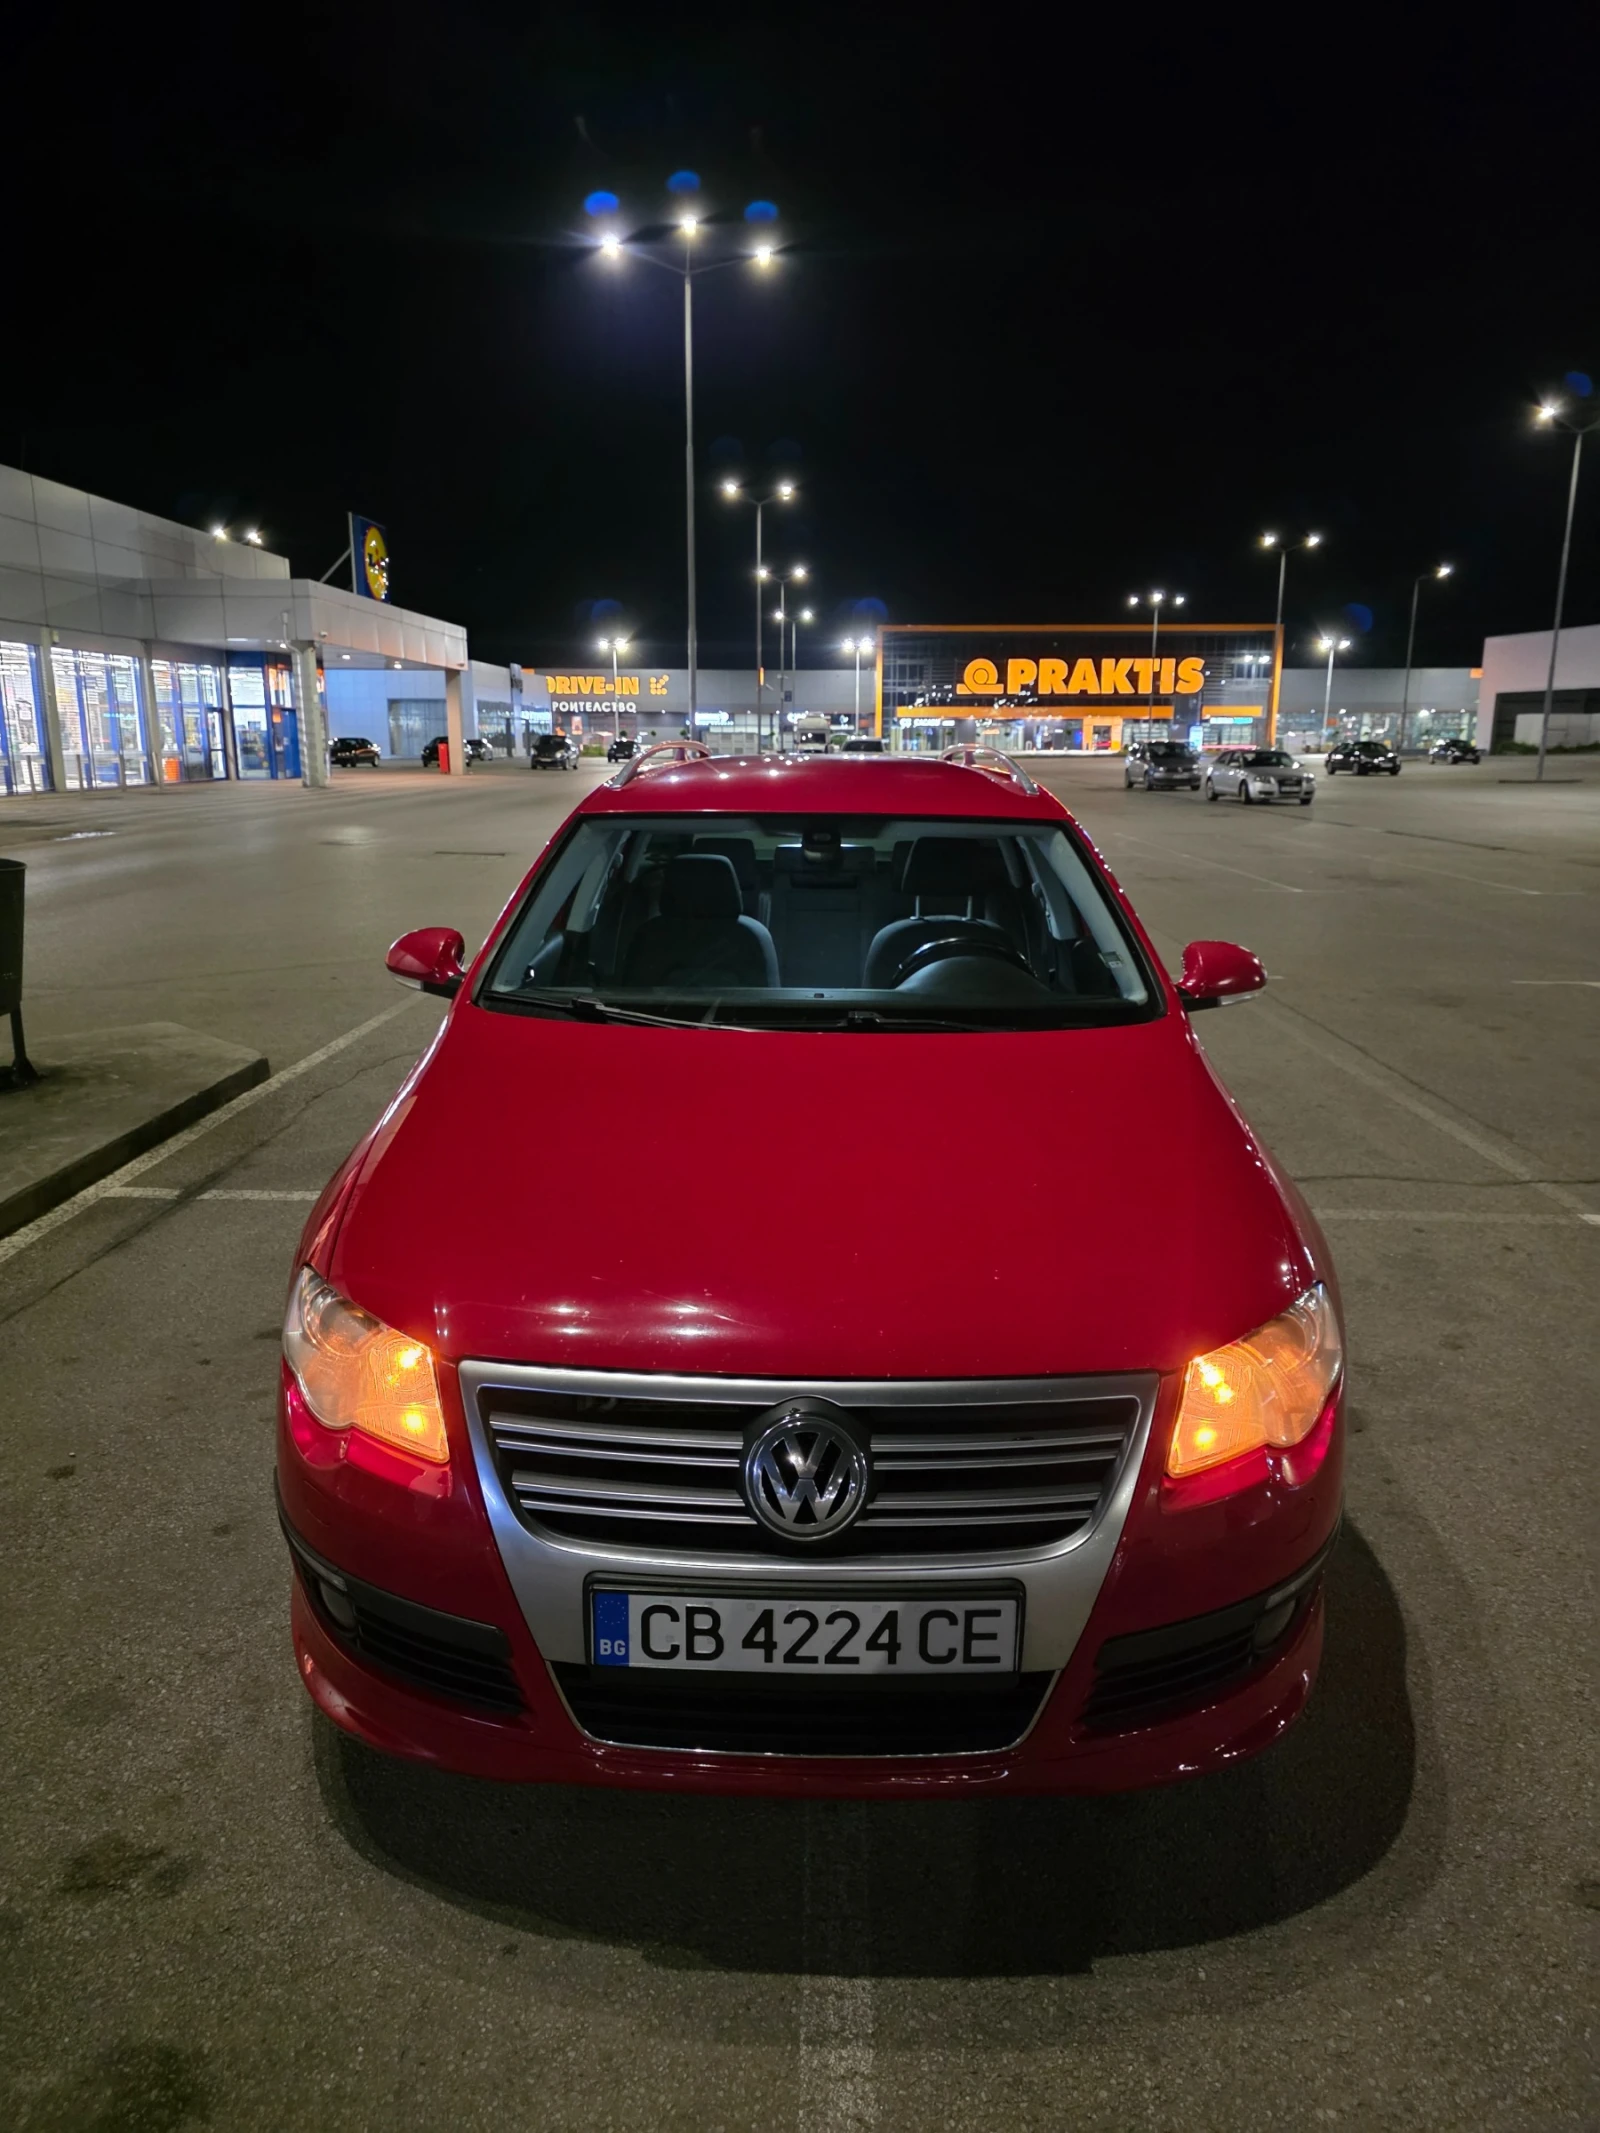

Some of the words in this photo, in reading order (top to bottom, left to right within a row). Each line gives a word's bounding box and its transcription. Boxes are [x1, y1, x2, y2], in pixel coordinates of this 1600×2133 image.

[546, 676, 639, 695] DRIVE-IN
[1007, 657, 1205, 694] PRAKTIS
[599, 1639, 626, 1656] BG
[640, 1604, 725, 1661] CB
[741, 1608, 902, 1665] 4224
[918, 1609, 1002, 1665] CE
